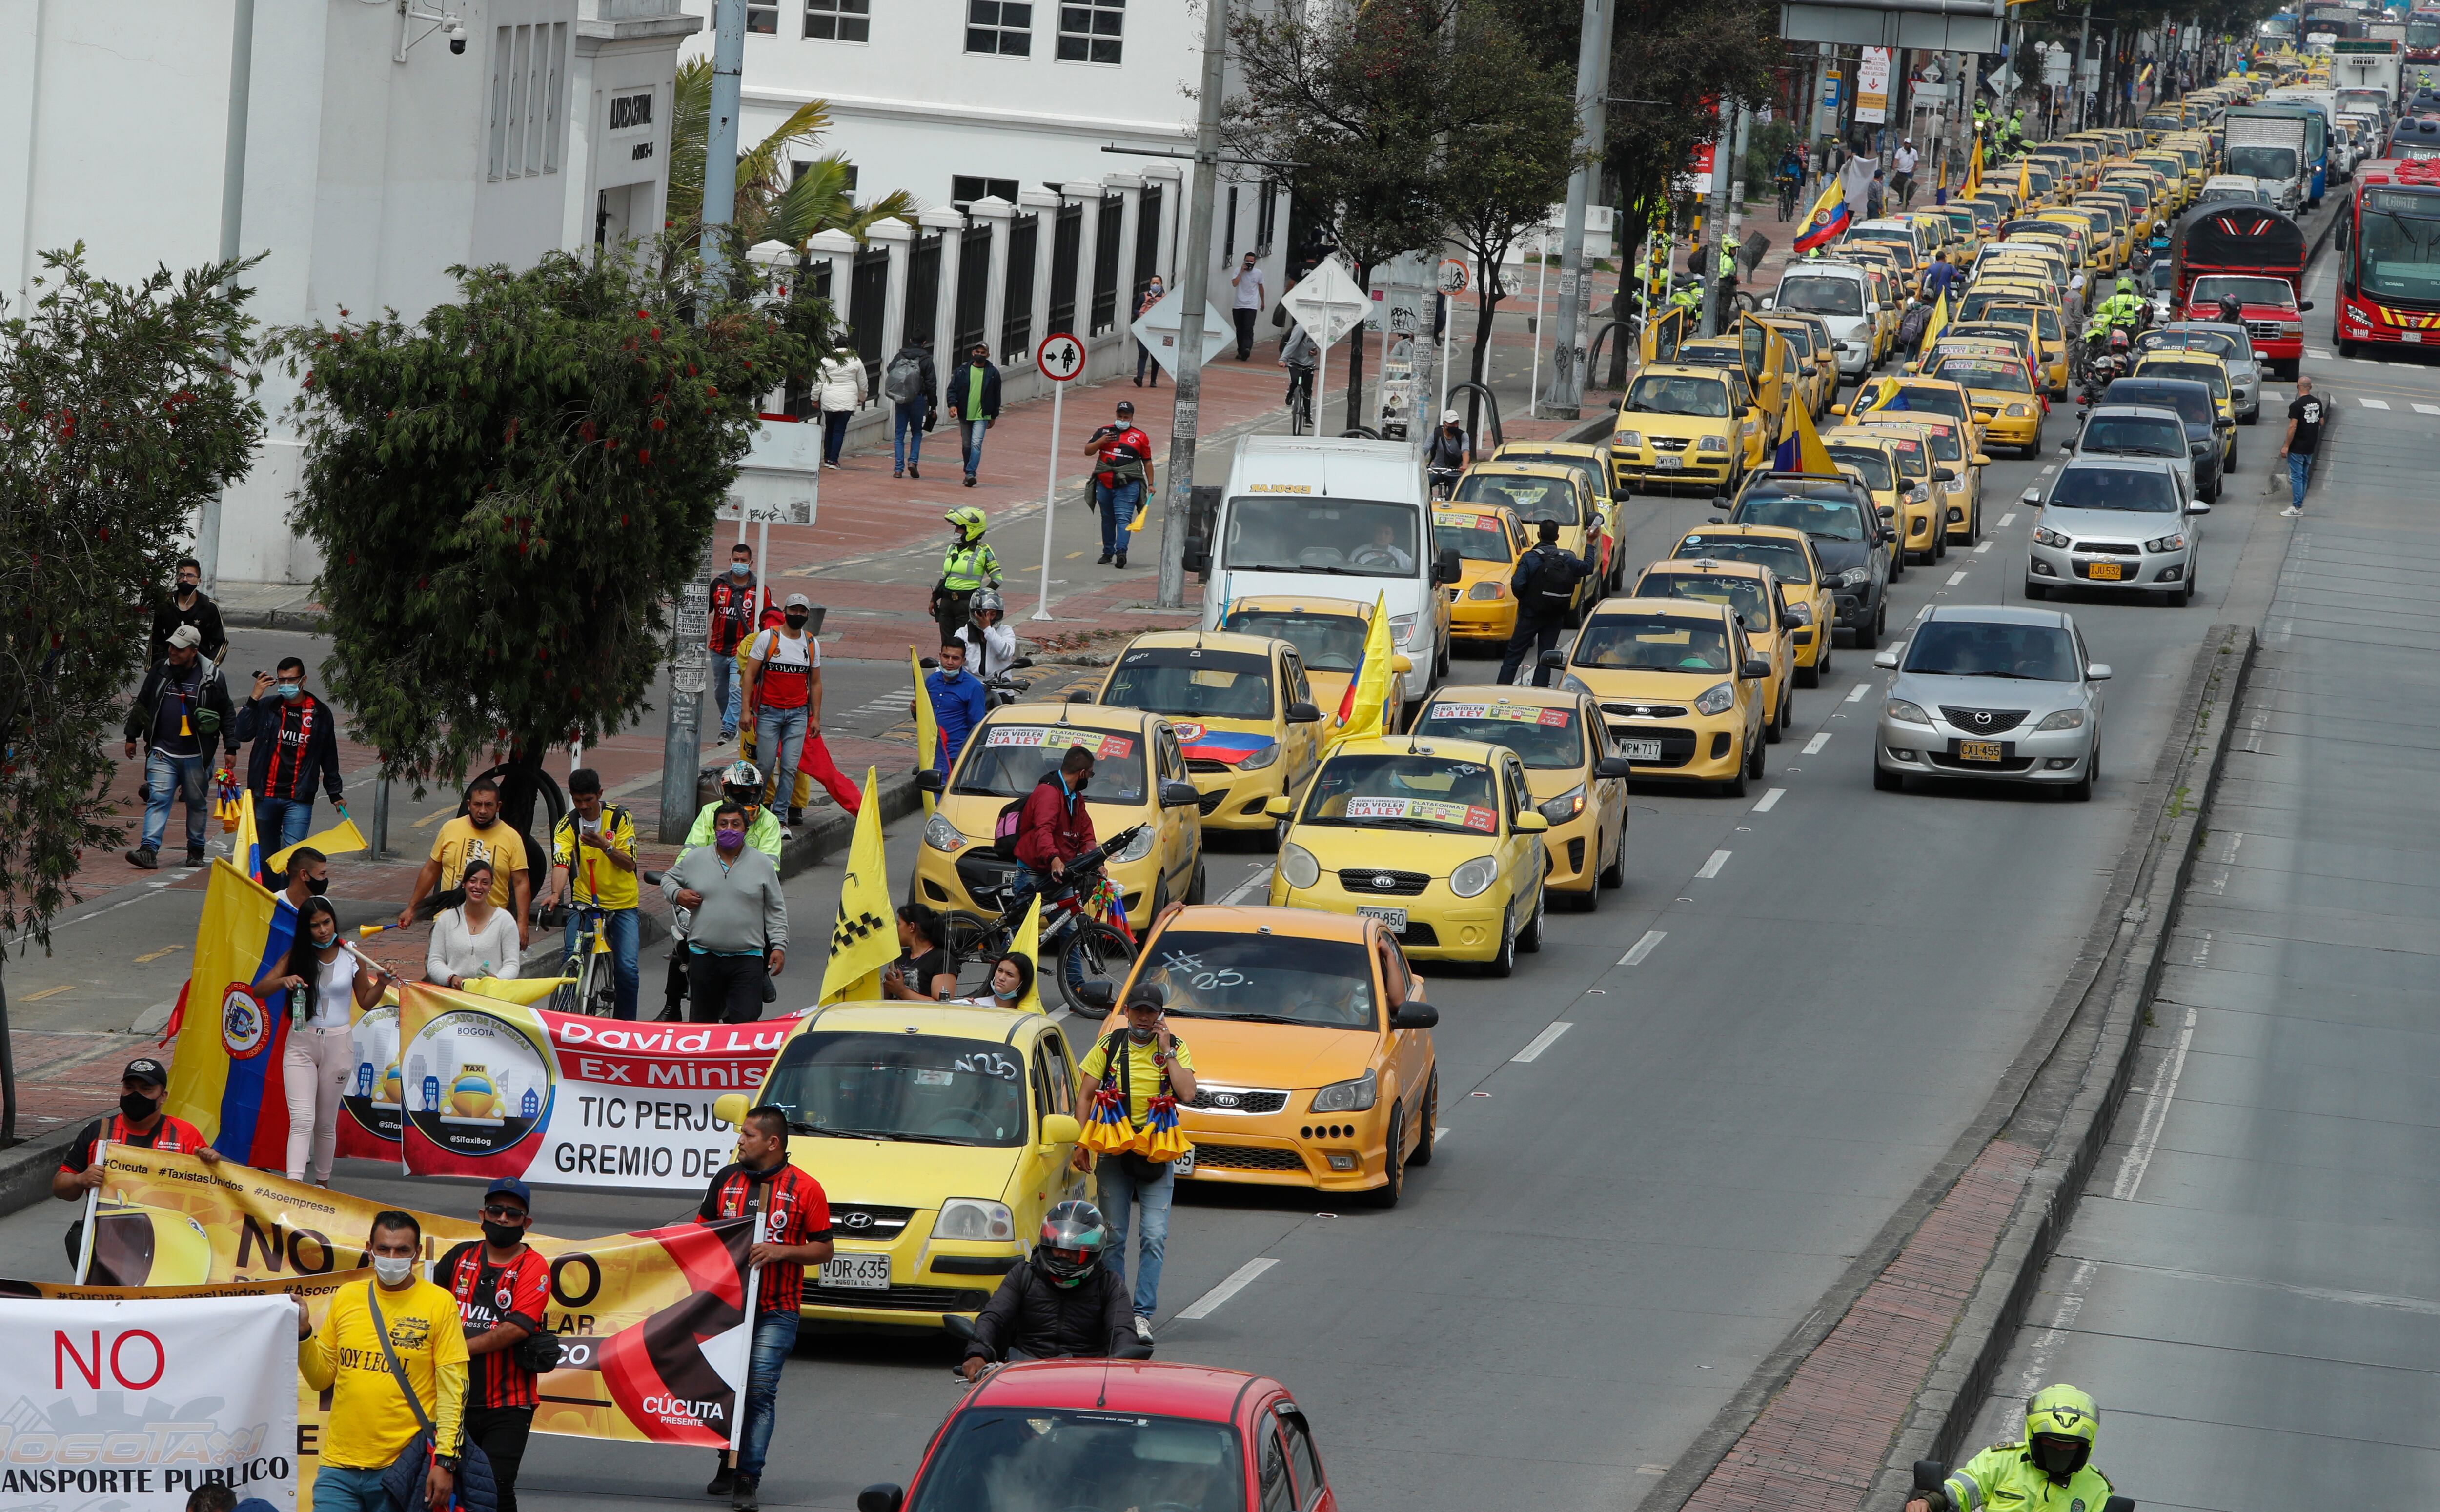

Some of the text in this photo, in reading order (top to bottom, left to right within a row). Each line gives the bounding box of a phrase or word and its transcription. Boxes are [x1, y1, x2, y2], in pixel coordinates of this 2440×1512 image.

[2353, 328, 2369, 337] M1469
[2091, 566, 2120, 575] IJU-532
[769, 663, 797, 673] POLO
[1050, 729, 1102, 740] PLATAFORMAS
[1016, 737, 1041, 745] LEY
[1621, 743, 1660, 755] WPM-717
[1961, 744, 2000, 756] CXI-455
[1412, 801, 1465, 811] PLATAFORMAS
[1470, 808, 1491, 817] Seguimos
[423, 1013, 530, 1051] SINDICATO DE TAXISTAS
[457, 1027, 495, 1037] BOGOTÁ
[560, 1021, 786, 1052] David Lu
[579, 1057, 768, 1087] Ex Minis
[579, 1096, 731, 1132] TIC PERJU
[379, 1120, 402, 1130] @SiTax
[450, 1135, 491, 1146] @SiTaxiBog
[555, 1142, 723, 1178] GREMIO DE
[103, 1159, 336, 1215] #Cucuta #TaxistasUnidos #Asoempresas
[236, 1213, 334, 1277] NO
[55, 1329, 165, 1390] NO
[340, 1347, 362, 1369] SOY
[643, 1393, 724, 1420] CÚCUTA
[660, 1416, 703, 1427] PRESENTE
[2, 1456, 290, 1494] ANSPORTE PUBLICO
